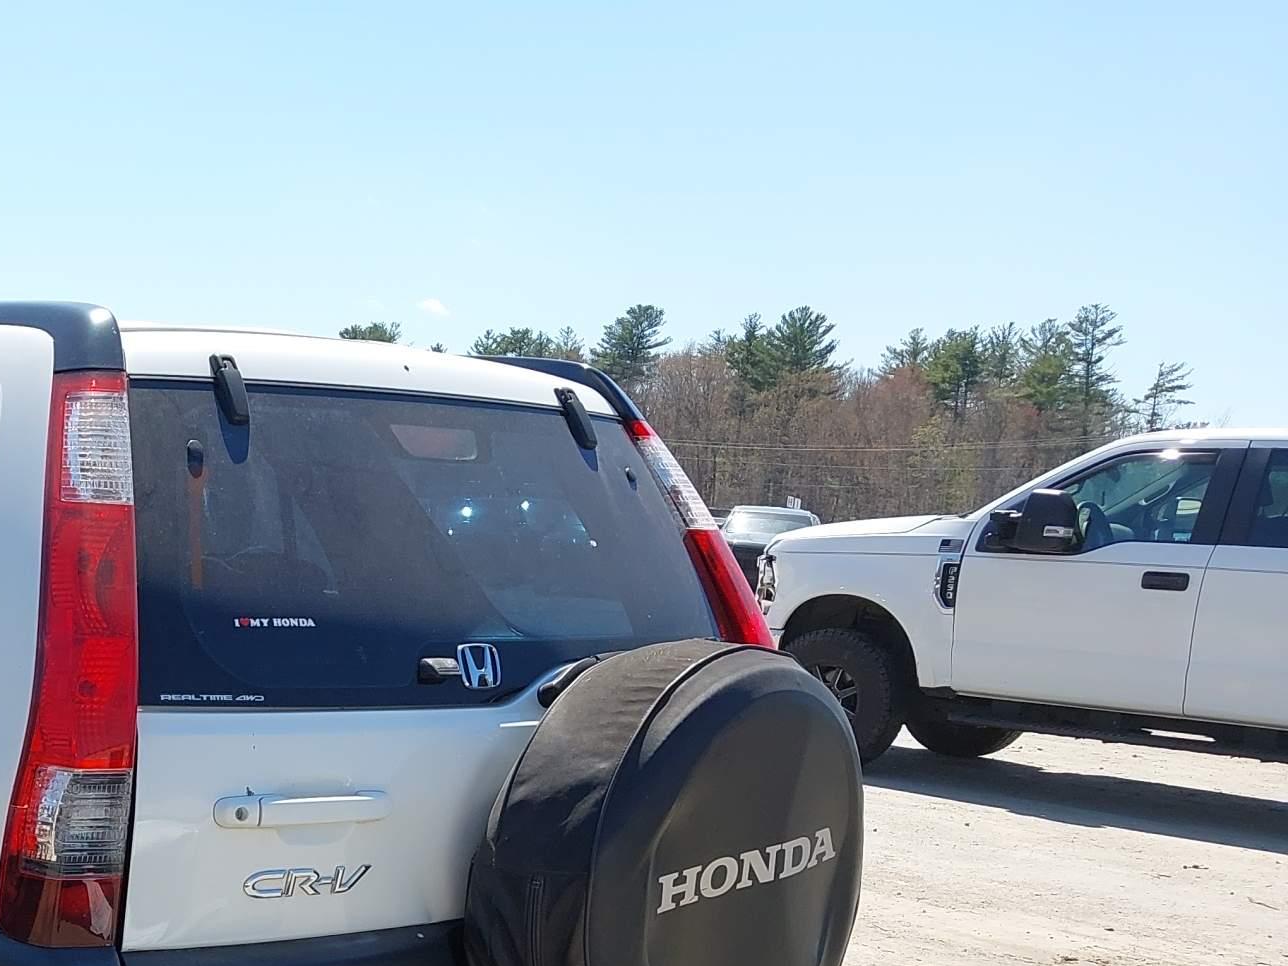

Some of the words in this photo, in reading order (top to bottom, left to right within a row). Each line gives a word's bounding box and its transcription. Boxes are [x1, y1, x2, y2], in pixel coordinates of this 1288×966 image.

[249, 618, 270, 628] MY
[272, 617, 316, 628] HONDA
[235, 694, 265, 702] 4WD
[243, 864, 372, 899] CR-V
[656, 827, 837, 915] HONDA
